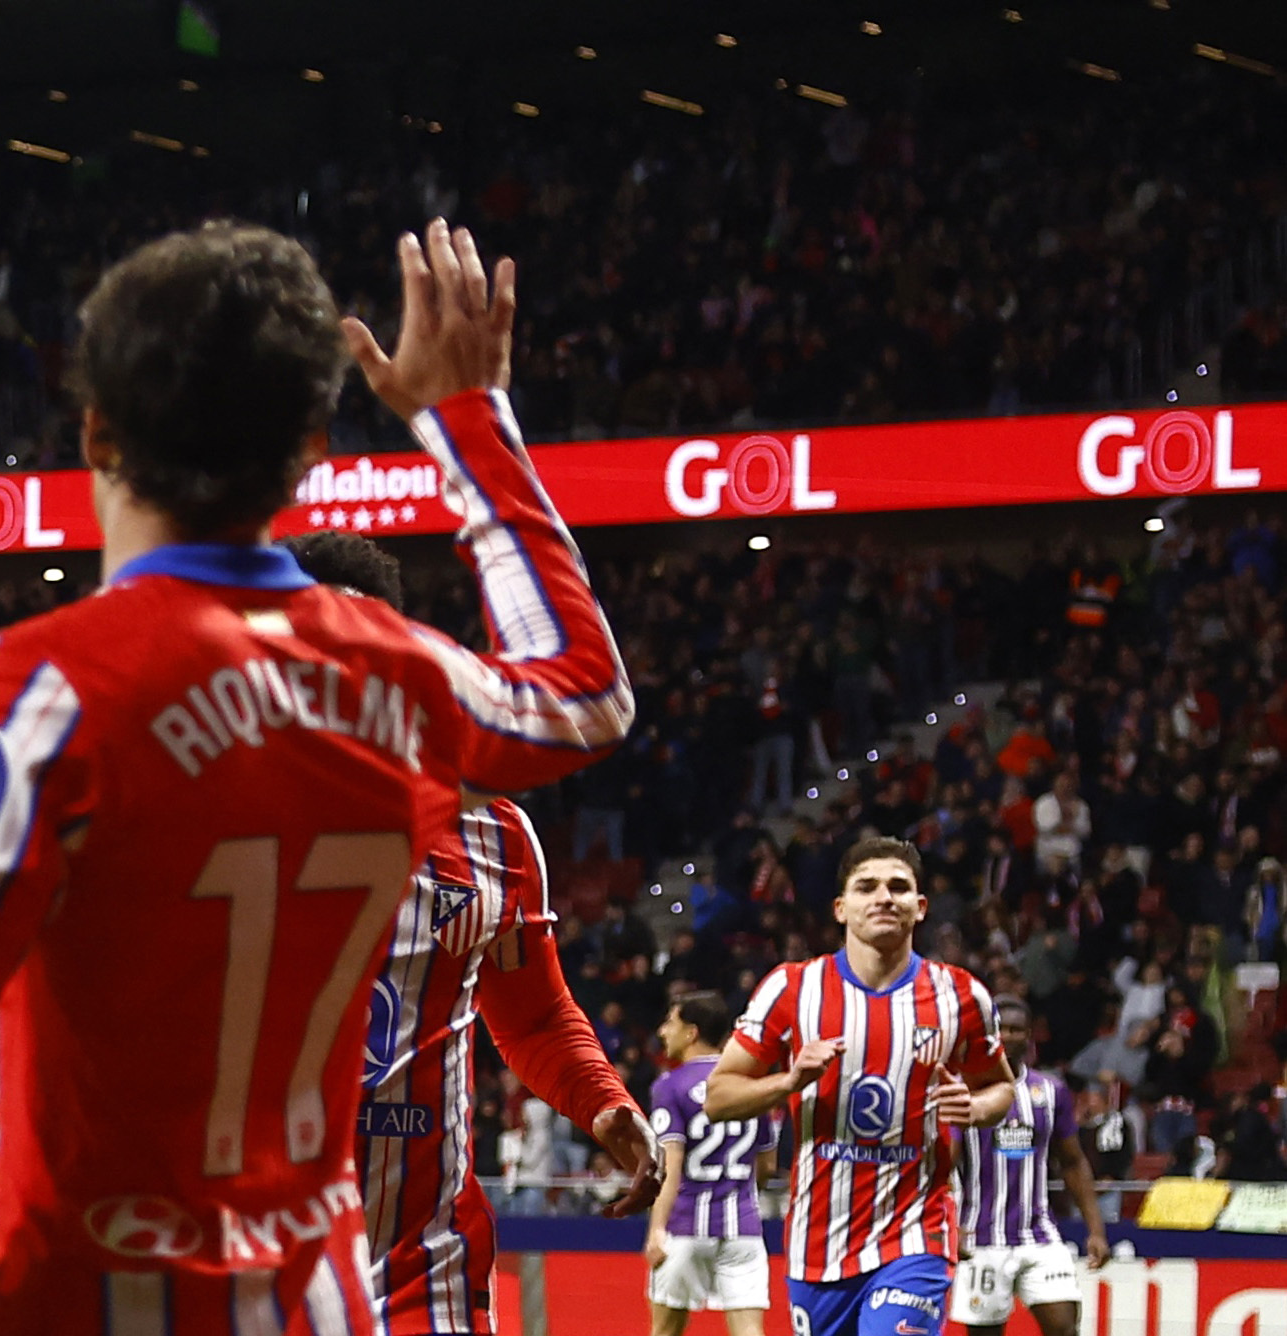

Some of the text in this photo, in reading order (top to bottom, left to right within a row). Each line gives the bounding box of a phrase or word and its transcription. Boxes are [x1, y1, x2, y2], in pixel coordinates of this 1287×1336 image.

[664, 434, 838, 518] GOL
[1077, 410, 1261, 495] GOL
[191, 831, 411, 1177] 17
[382, 1107, 426, 1132] AIR
[687, 1111, 758, 1181] 22
[968, 1265, 996, 1295] 16
